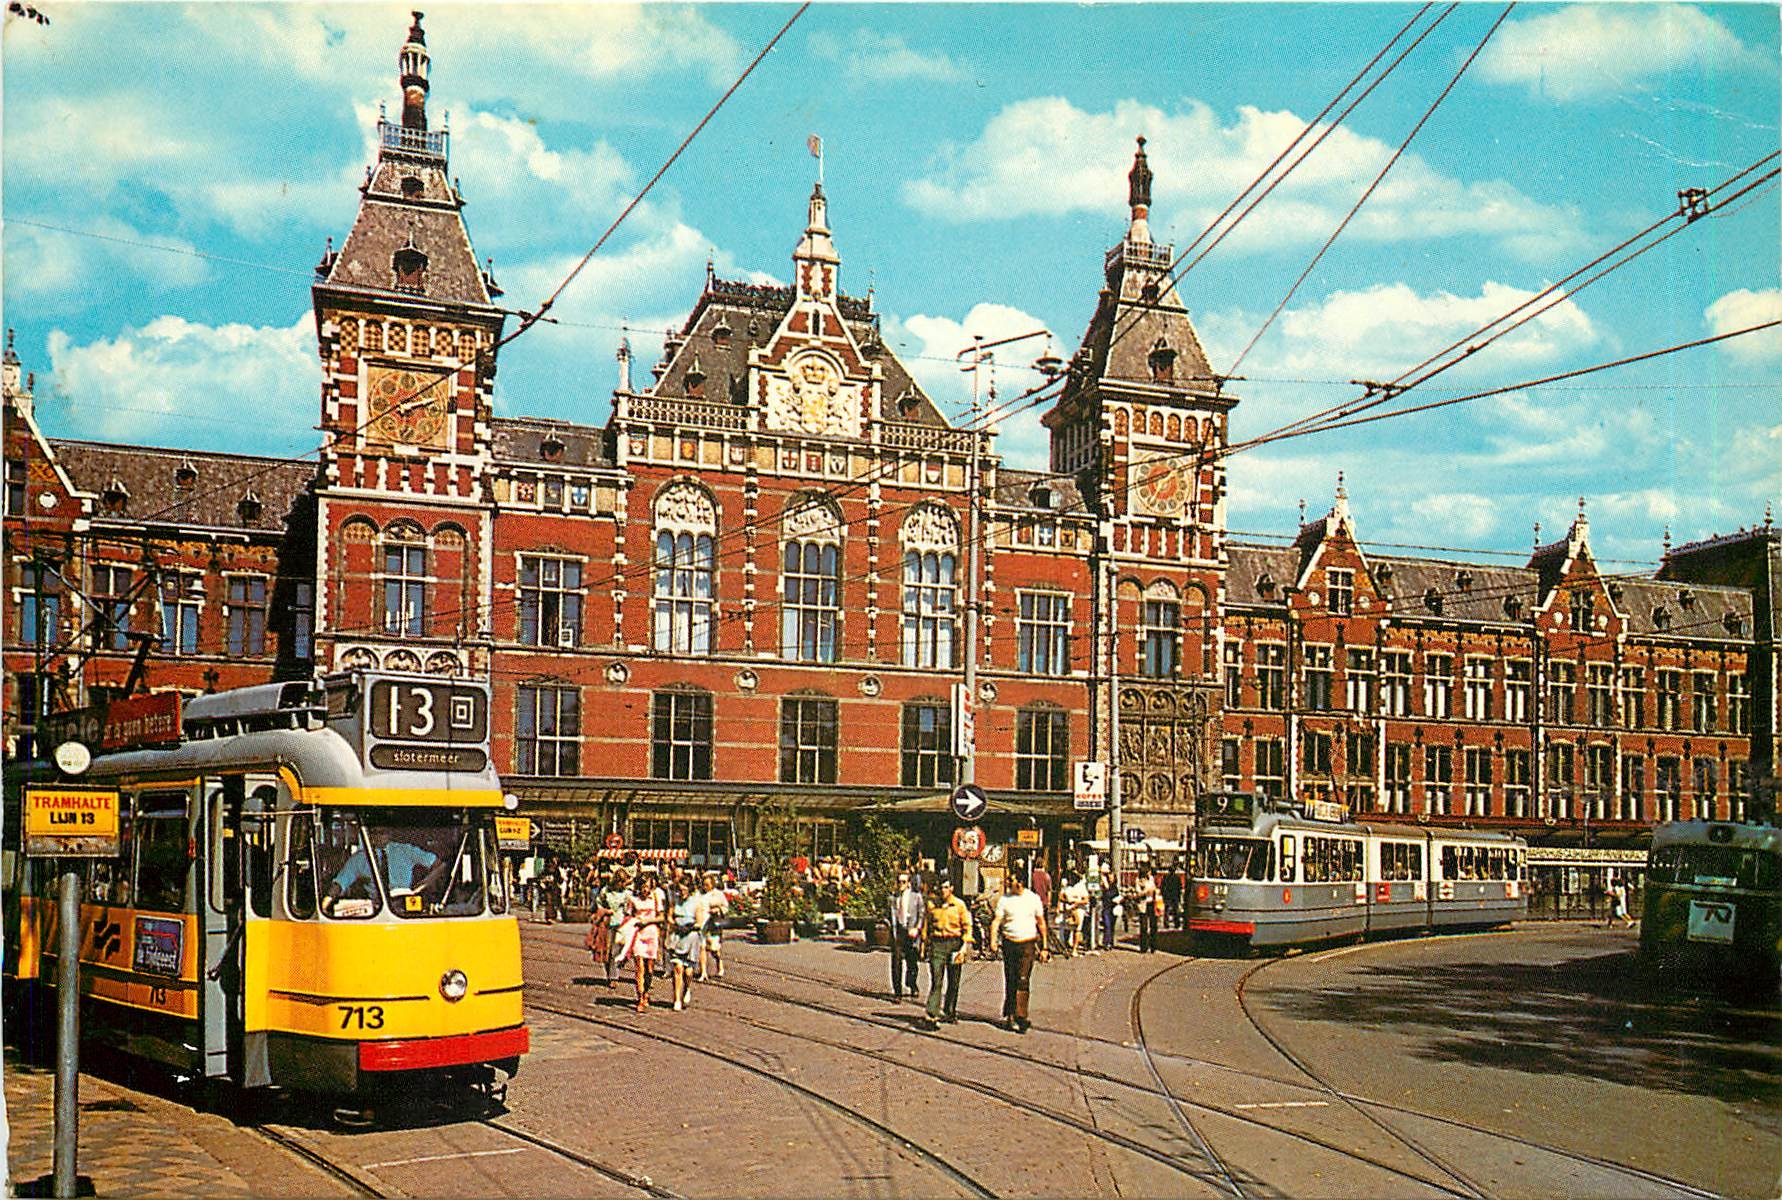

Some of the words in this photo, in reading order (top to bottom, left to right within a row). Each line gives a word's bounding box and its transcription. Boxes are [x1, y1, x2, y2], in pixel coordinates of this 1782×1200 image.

[389, 686, 435, 736] 13
[393, 751, 459, 763] slotermeer
[32, 796, 111, 809] TRAMHALTE
[1216, 796, 1228, 813] 9
[49, 812, 77, 824] LIJN
[80, 812, 95, 825] 13
[338, 1006, 385, 1030] 713
